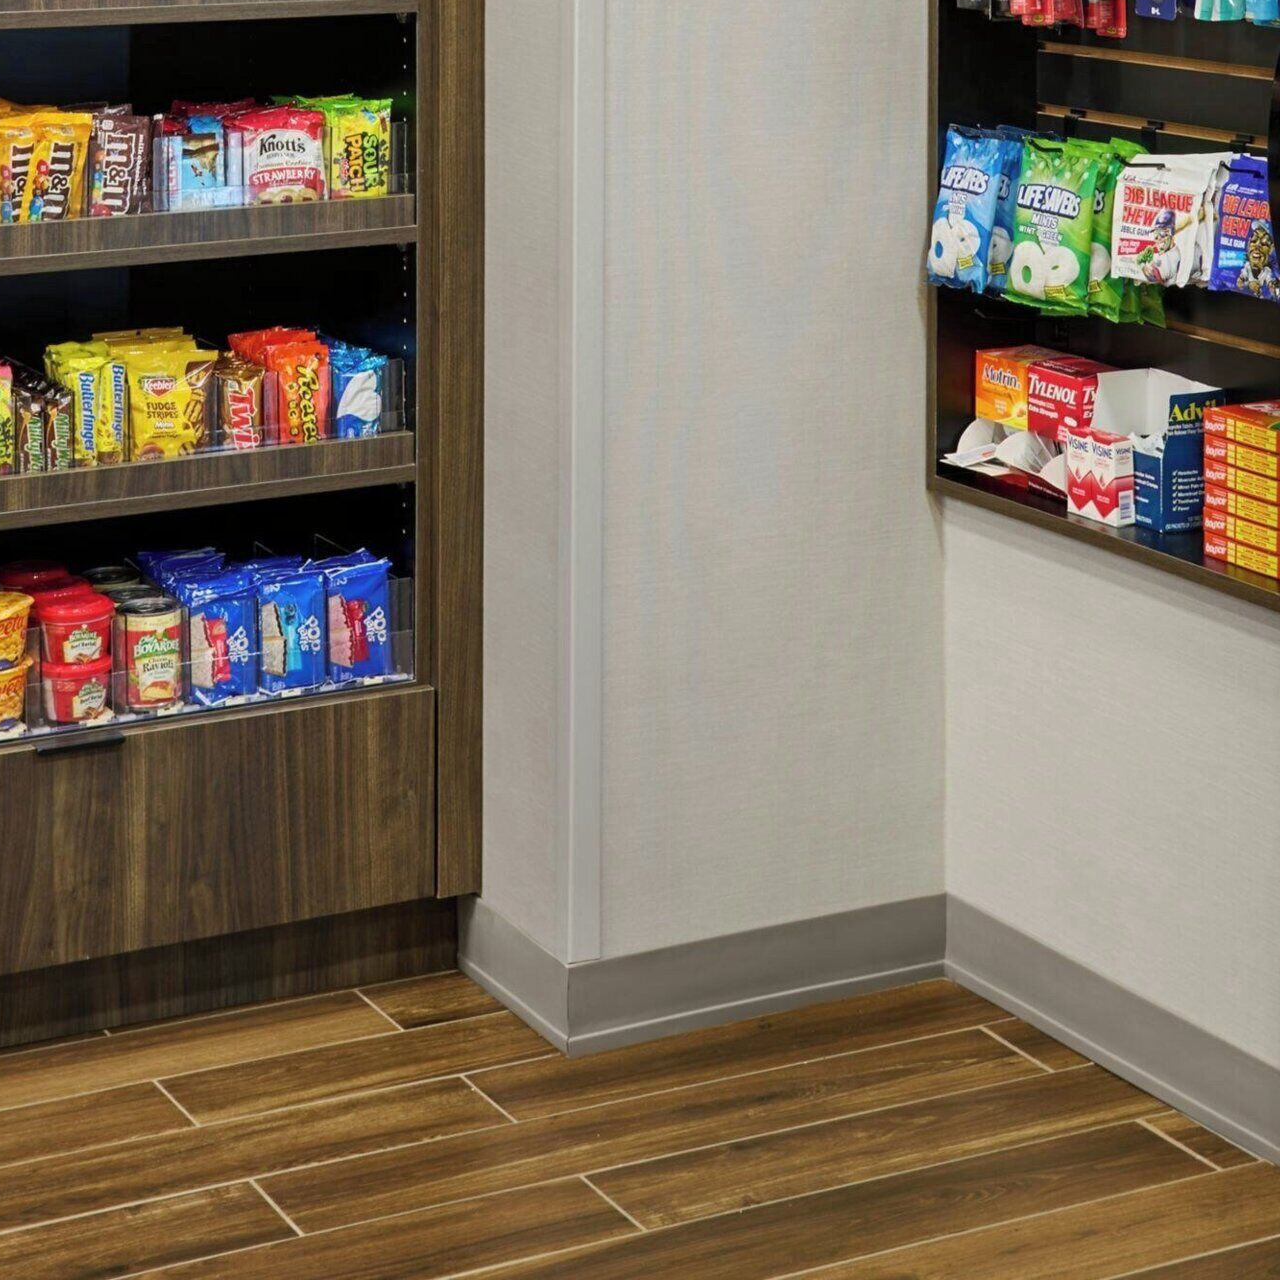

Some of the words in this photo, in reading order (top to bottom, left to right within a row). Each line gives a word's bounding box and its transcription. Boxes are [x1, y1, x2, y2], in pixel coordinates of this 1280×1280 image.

[259, 134, 306, 154] Knott's
[252, 169, 316, 186] STRAWBERRY
[1018, 184, 1044, 208] LIFE
[1146, 188, 1194, 213] LEAGUE
[1031, 213, 1059, 228] MINTS
[143, 379, 176, 392] Keebler
[982, 364, 1020, 389] Motrin
[1028, 373, 1078, 405] TYLENOL
[78, 371, 96, 454] Butterfinger
[146, 402, 176, 411] FUDGE
[146, 410, 179, 420] STRIPES
[1068, 434, 1089, 453] VISINE
[1091, 442, 1114, 460] VISINE
